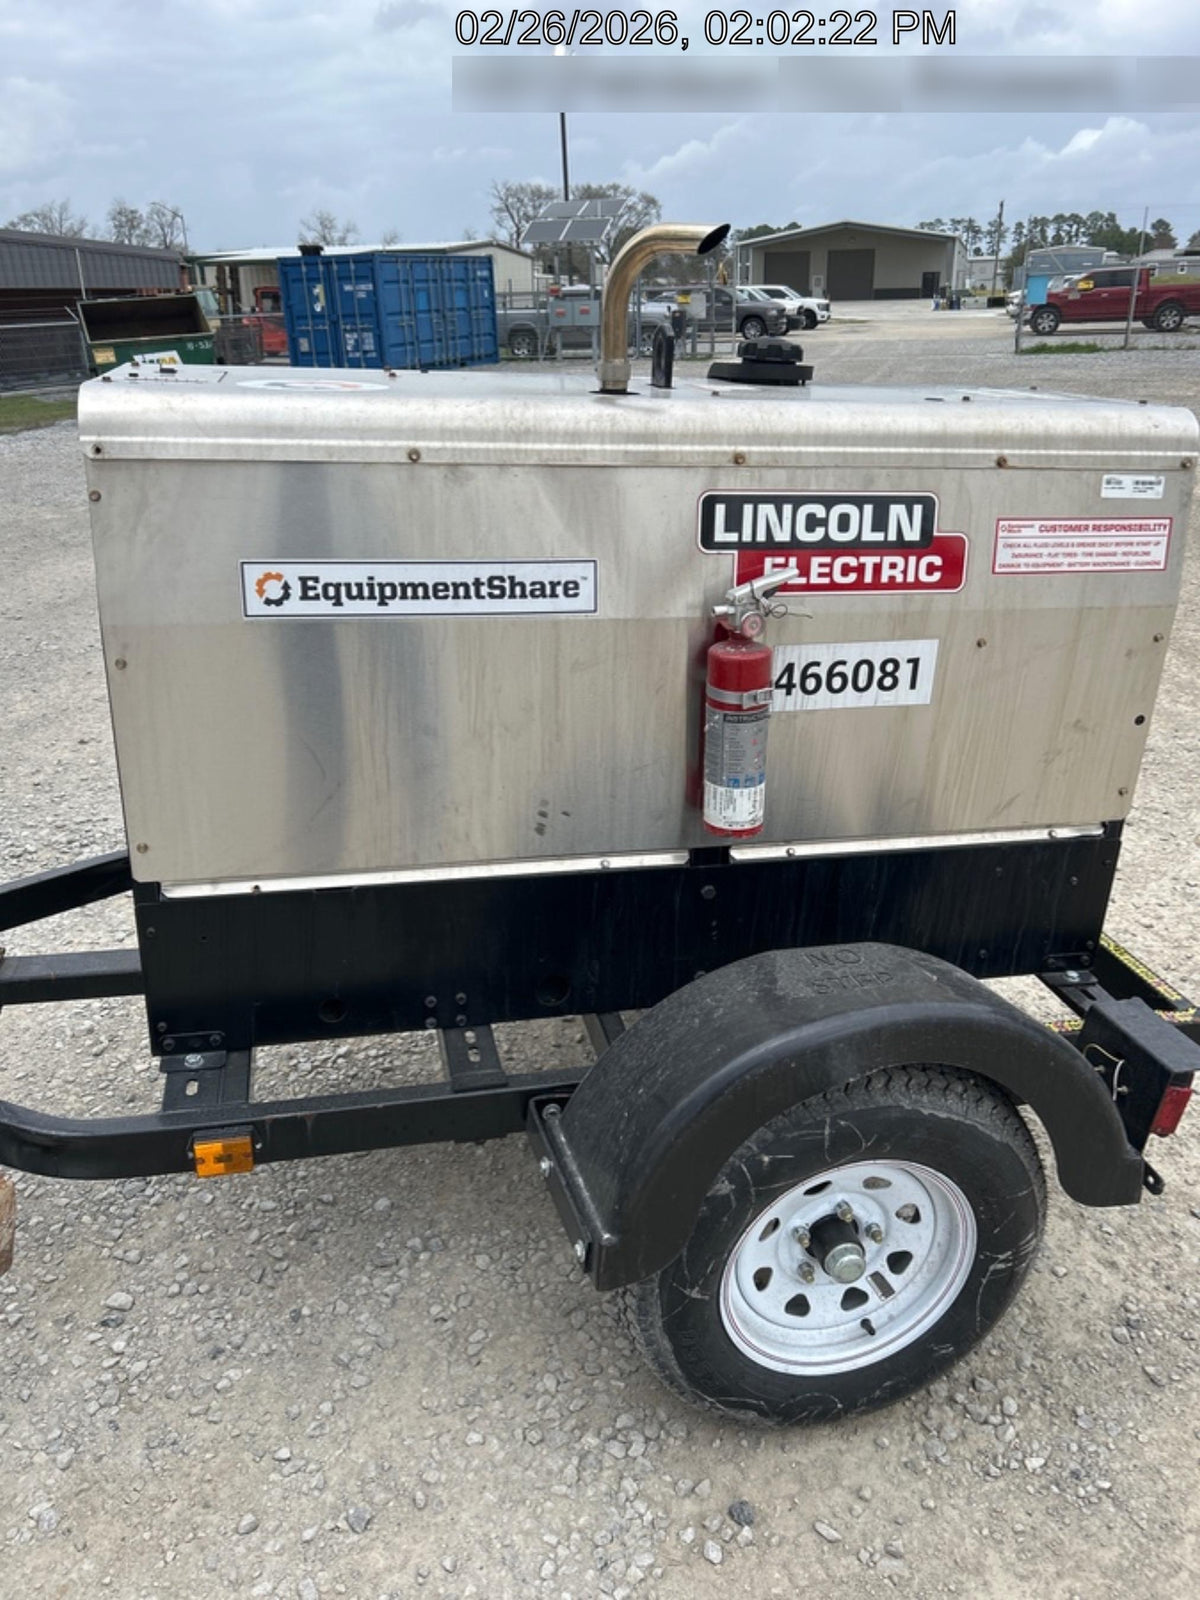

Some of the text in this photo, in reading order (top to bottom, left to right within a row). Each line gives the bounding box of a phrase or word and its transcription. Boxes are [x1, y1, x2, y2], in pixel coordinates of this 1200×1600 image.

[714, 503, 923, 542] LINCOLN
[1038, 524, 1089, 533] CUSTOMER
[1092, 523, 1167, 532] RESPONSIBILITY
[299, 576, 580, 606] EquipmentShare
[774, 657, 921, 696] 466081
